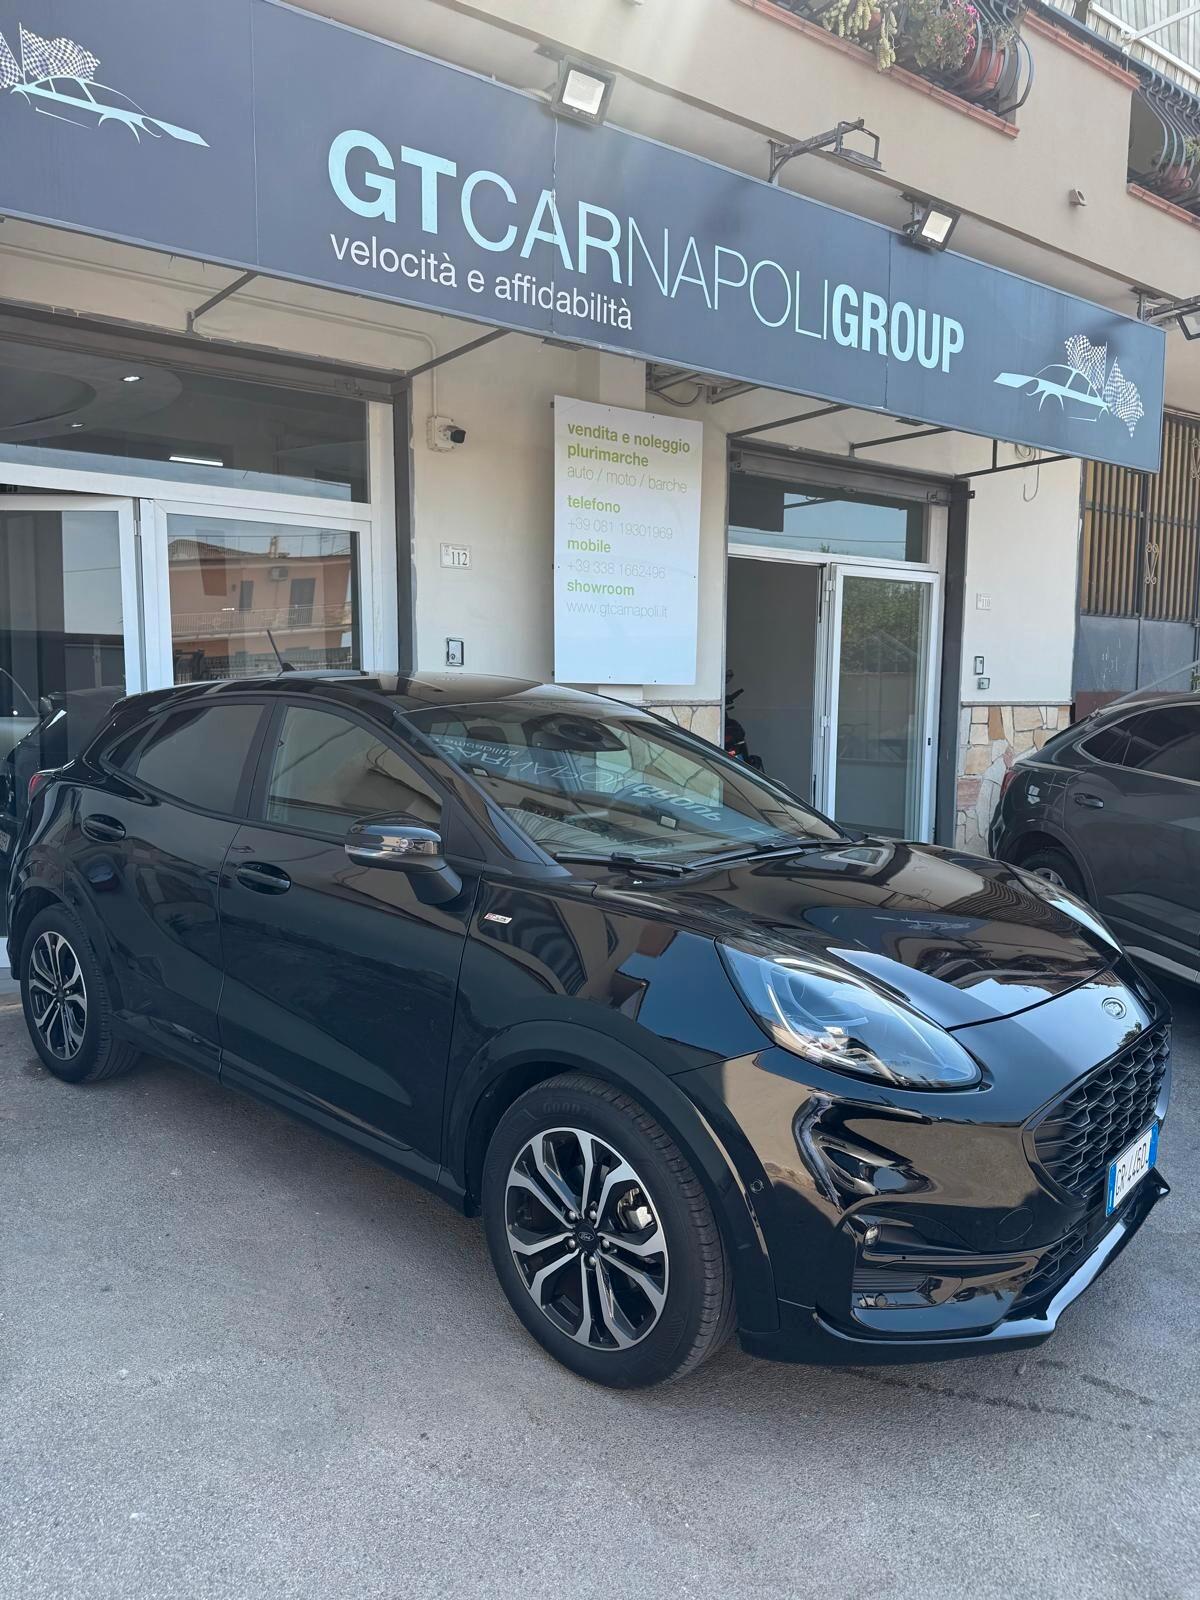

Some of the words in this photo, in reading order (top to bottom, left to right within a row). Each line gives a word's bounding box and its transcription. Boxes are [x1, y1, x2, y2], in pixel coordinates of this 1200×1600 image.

[330, 233, 458, 289] velocità
[466, 268, 485, 294] e
[494, 272, 633, 331] affidabilità
[567, 423, 618, 442] vendita
[622, 433, 630, 443] e
[634, 434, 690, 454] noleggio
[567, 443, 649, 467] plurimarche
[567, 466, 594, 481] auto
[606, 471, 637, 487] moto
[648, 475, 688, 493] barche
[567, 495, 621, 513] telefono
[567, 516, 591, 531] +39
[567, 538, 612, 553] mobile
[451, 551, 468, 566] 112
[567, 558, 591, 573] +39
[567, 579, 635, 596] showroom
